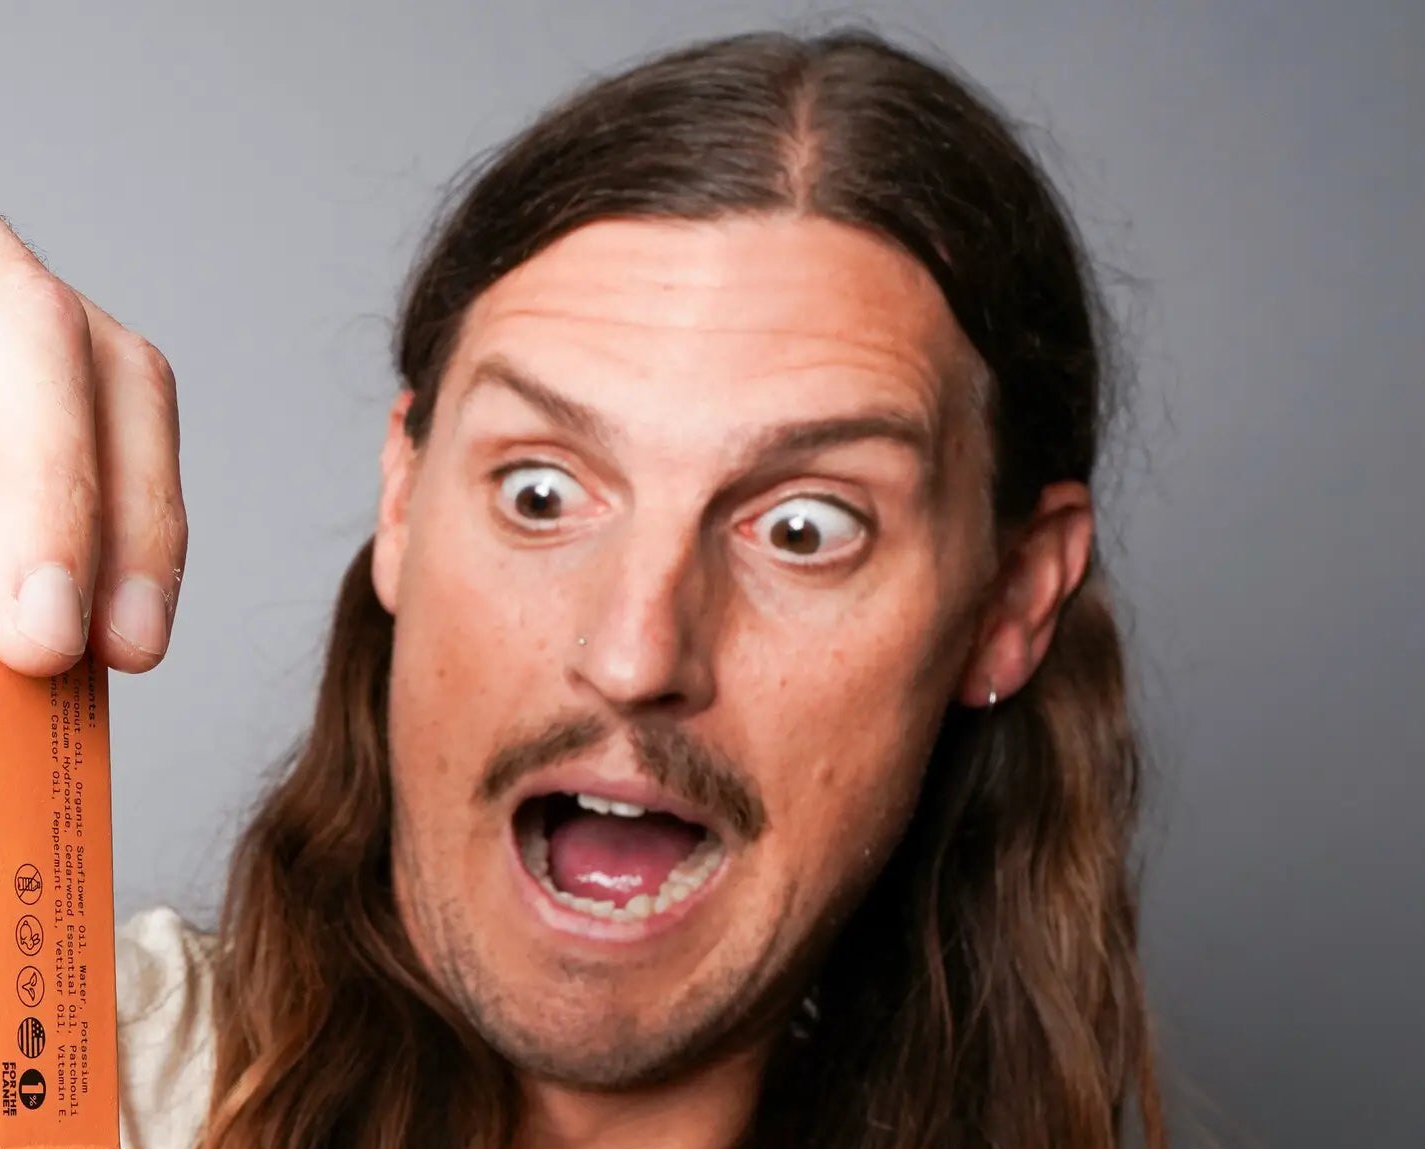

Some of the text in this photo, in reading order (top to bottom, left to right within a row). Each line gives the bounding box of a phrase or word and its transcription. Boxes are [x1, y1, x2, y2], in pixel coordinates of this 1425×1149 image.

[51, 715, 59, 762] Castor
[74, 742, 82, 770] Oil,
[52, 771, 61, 800] Oil,
[62, 757, 72, 833] Hydroxide,
[74, 782, 83, 837] Organic
[52, 811, 62, 890] Peppermint
[65, 844, 74, 916] Cedarwood
[76, 845, 86, 916] Sunflower
[54, 900, 63, 929] Oil,
[78, 926, 86, 954] Oil,
[67, 925, 76, 996] Essential
[57, 1004, 65, 1033] Oil,
[68, 1004, 77, 1033] Oil,
[57, 1045, 65, 1100] Vitamin
[70, 1045, 78, 1116] Patchouli
[81, 1021, 90, 1093] Potassium
[2, 1062, 10, 1116] PLANET
[21, 1082, 44, 1106] 1%
[58, 1109, 66, 1123] E.
